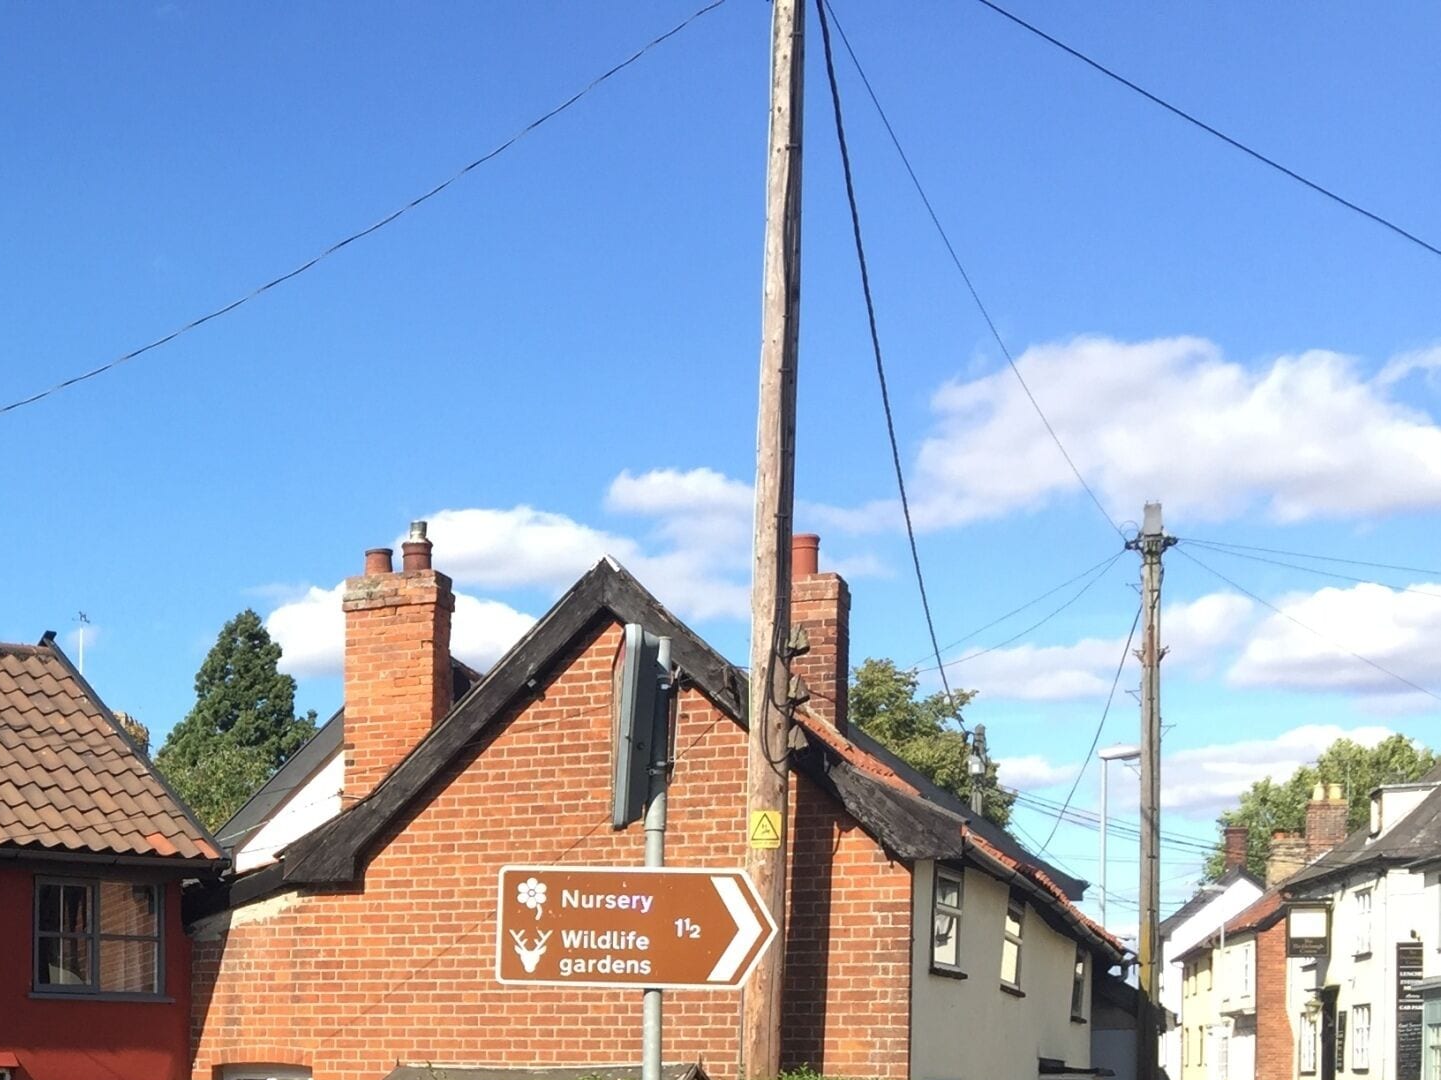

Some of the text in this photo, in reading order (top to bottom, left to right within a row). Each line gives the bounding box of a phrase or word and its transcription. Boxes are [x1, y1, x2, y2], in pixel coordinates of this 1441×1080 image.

[561, 889, 654, 913] Nursery
[561, 930, 651, 951] Wildlife
[559, 955, 652, 977] gardens
